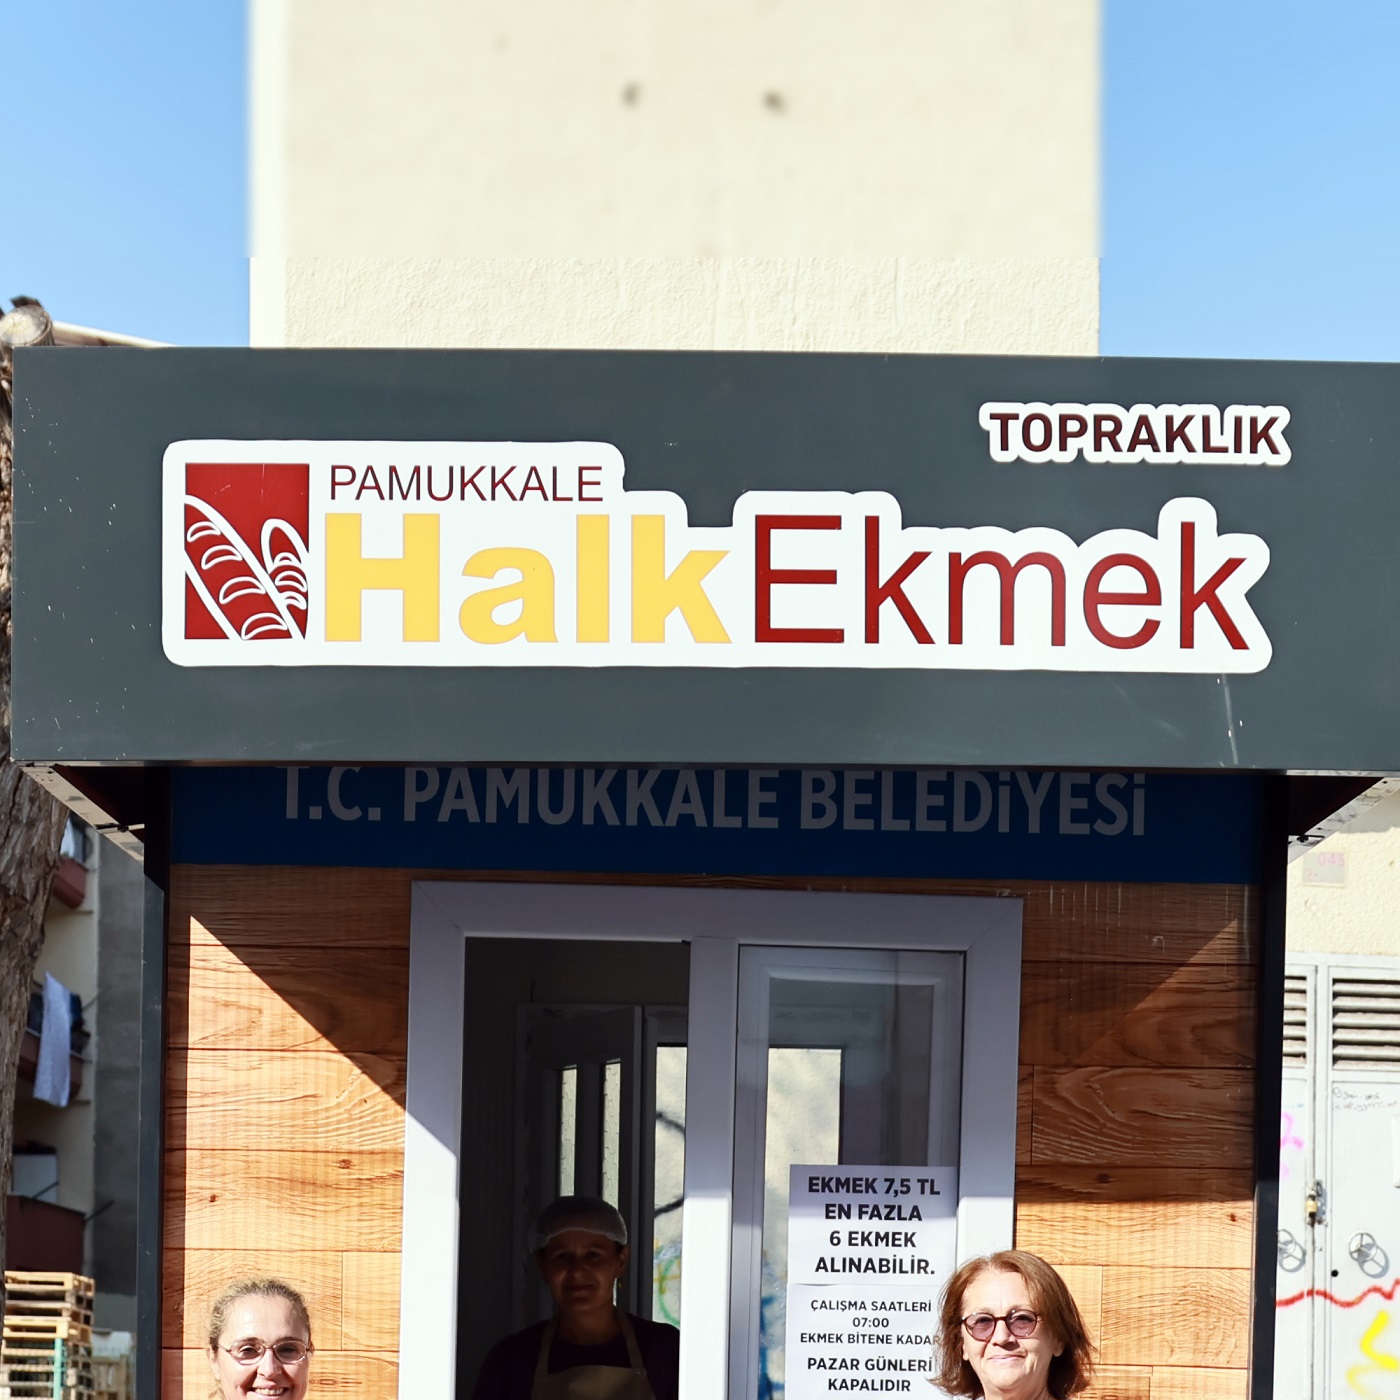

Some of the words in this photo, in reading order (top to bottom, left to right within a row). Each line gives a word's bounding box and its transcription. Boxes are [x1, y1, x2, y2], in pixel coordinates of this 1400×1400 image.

[989, 412, 1281, 455] TOPRAKLIK
[330, 464, 604, 502] PAMUKKALE
[276, 766, 381, 821] T.C.
[403, 767, 779, 828] PAMUKKALE
[808, 1176, 878, 1195] EKMEK
[883, 1177, 911, 1198] 7,5
[917, 1178, 941, 1196] TL
[825, 1203, 852, 1220] EN
[858, 1203, 923, 1221] FAZLA
[829, 1230, 841, 1247] 6
[848, 1231, 917, 1248] EKMEK
[815, 1254, 936, 1275] ALINABİLİR.
[810, 1299, 867, 1312] ÇALIŞMA
[871, 1299, 932, 1312] SAATLERİ
[852, 1317, 890, 1328] 07:00
[800, 1332, 844, 1344] EKMEK
[847, 1331, 893, 1345] BİTENE
[807, 1357, 860, 1371] PAZAR
[864, 1355, 932, 1372] GÜNLERİ
[828, 1378, 911, 1392] KAPALIDIR
